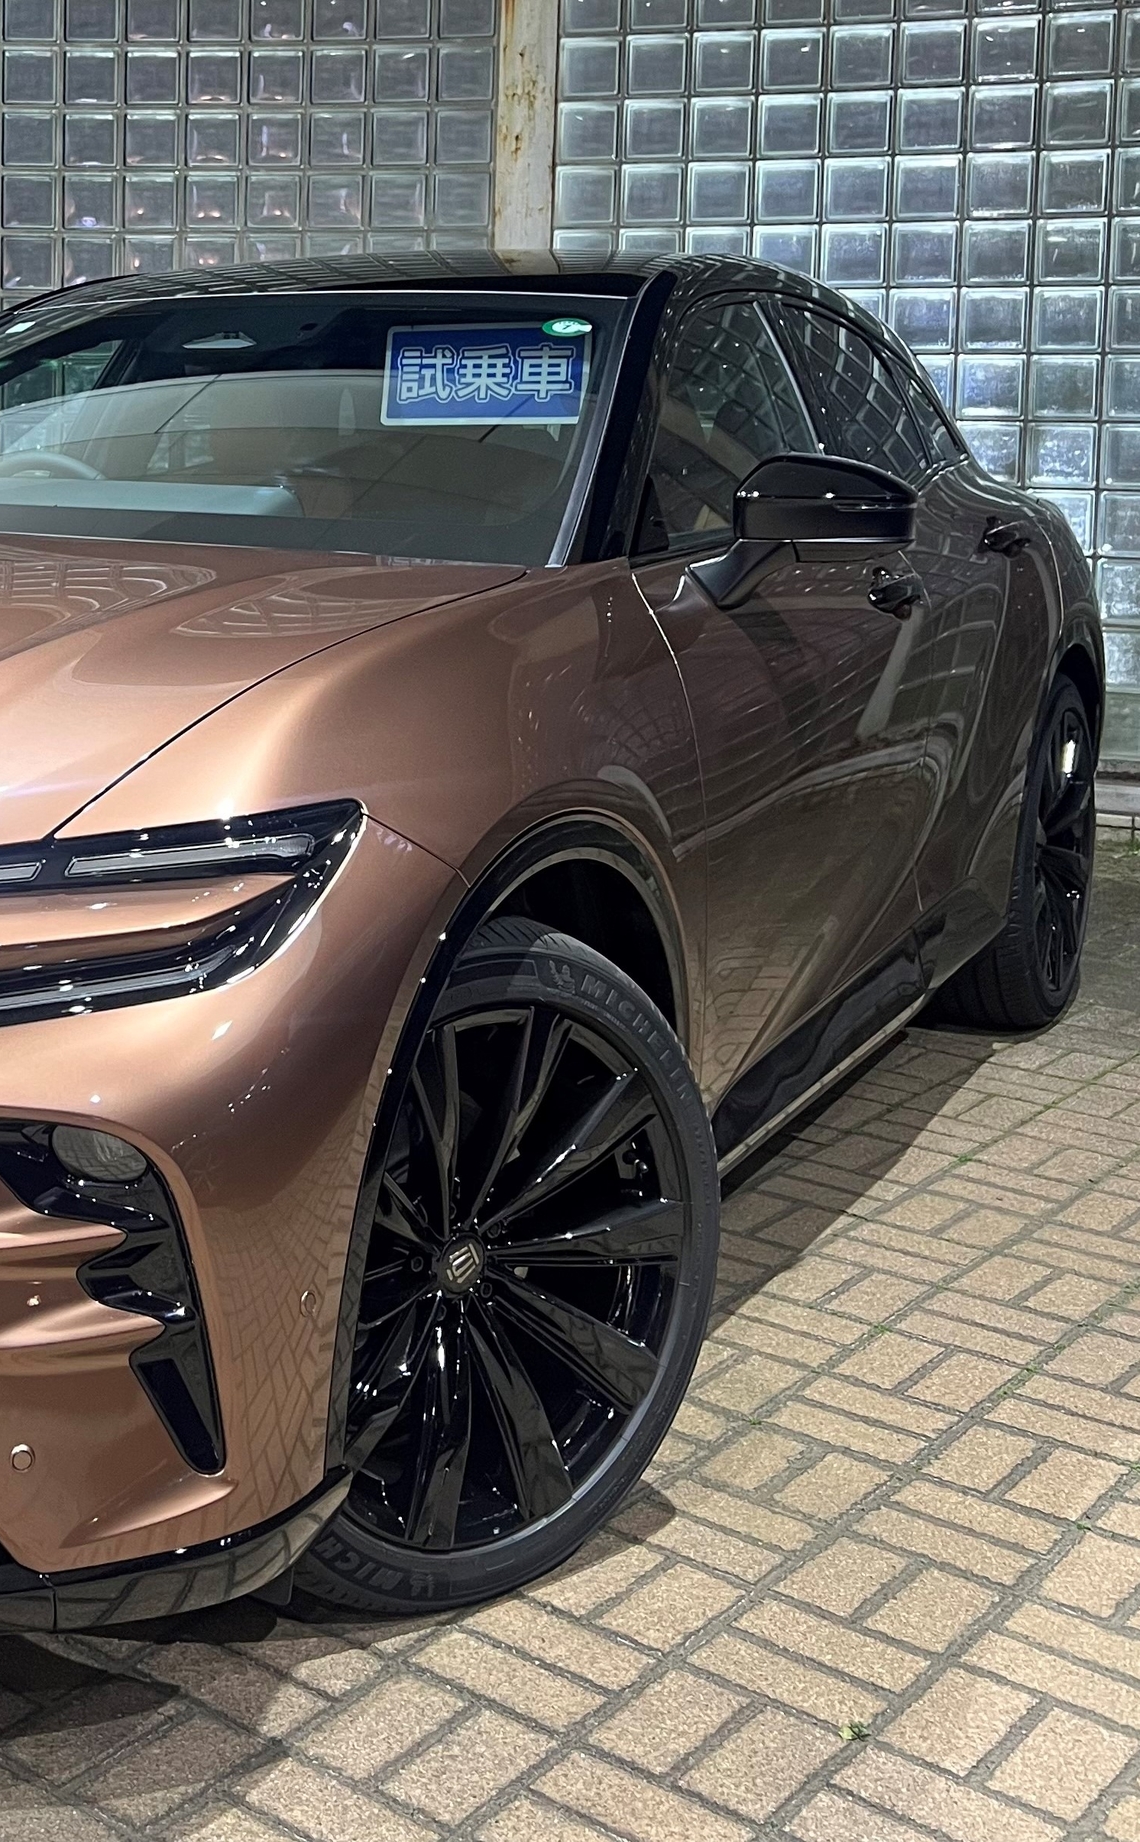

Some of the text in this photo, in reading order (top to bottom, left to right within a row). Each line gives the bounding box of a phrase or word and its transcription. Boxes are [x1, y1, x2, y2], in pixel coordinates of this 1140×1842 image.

[398, 343, 574, 403] 試乗車
[581, 974, 695, 1103] MICHELIN
[313, 1534, 403, 1591] MICH
